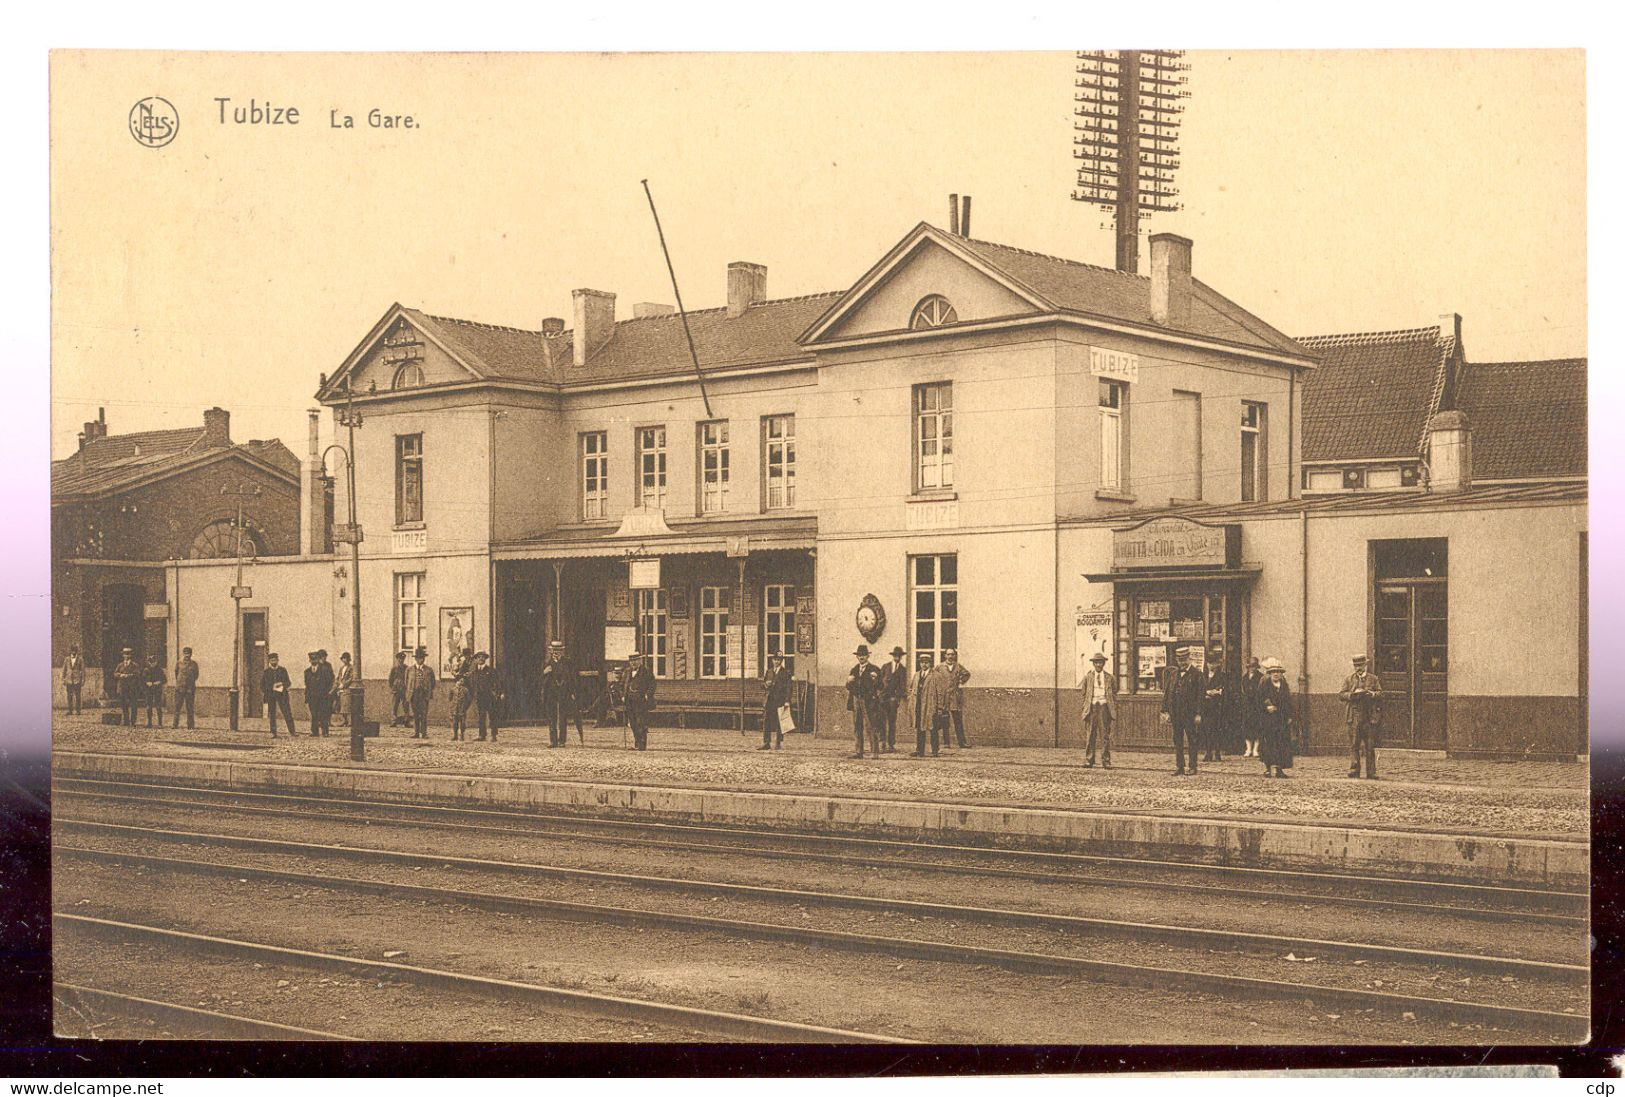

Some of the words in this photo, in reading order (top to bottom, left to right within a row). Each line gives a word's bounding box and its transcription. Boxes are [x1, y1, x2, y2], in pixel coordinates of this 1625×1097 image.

[214, 97, 300, 124] Tubize
[331, 109, 354, 129] La
[368, 108, 420, 129] Gare.
[1091, 351, 1138, 377] TUBIZE
[907, 504, 957, 525] TUBIZE
[392, 532, 426, 549] TUBIZE
